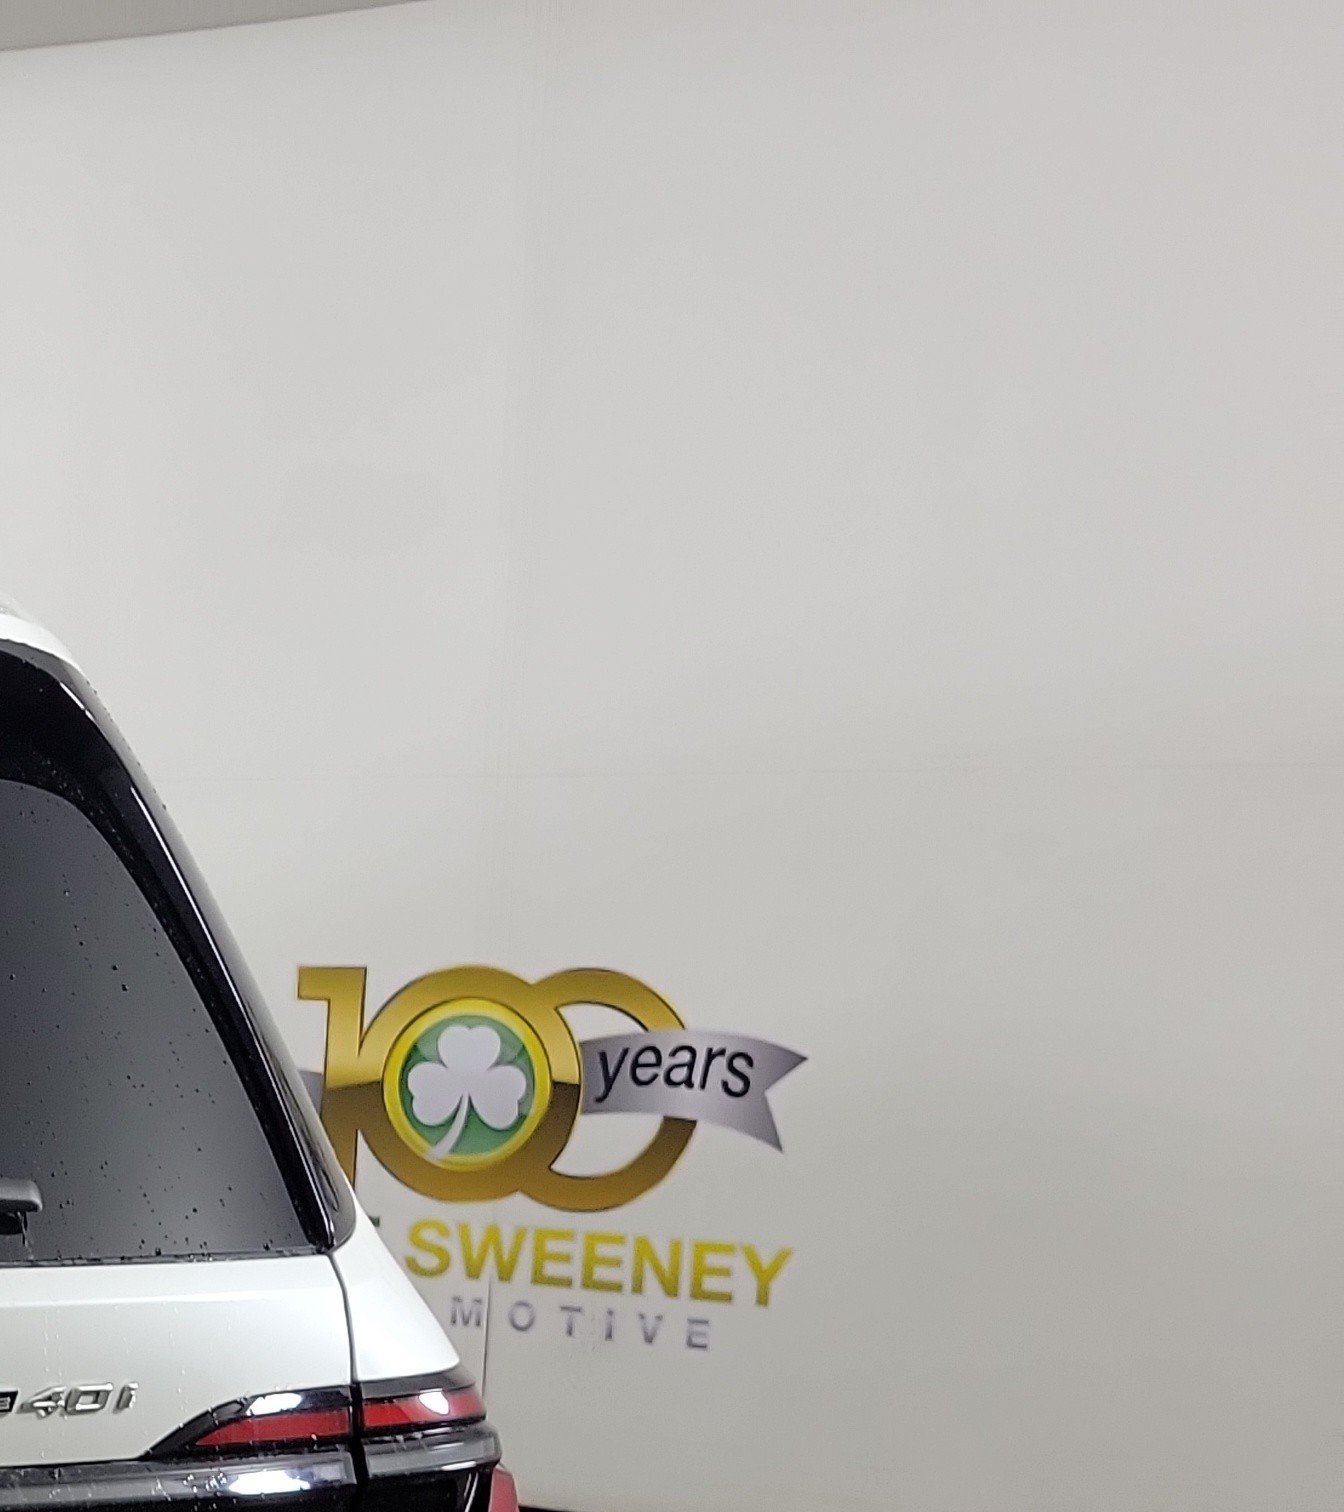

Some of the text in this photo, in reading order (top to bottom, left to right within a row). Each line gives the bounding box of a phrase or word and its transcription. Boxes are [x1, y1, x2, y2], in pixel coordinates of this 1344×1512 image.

[592, 1042, 756, 1104] years
[405, 1217, 794, 1308] SWEENEY
[449, 1295, 711, 1350] MOTIVE
